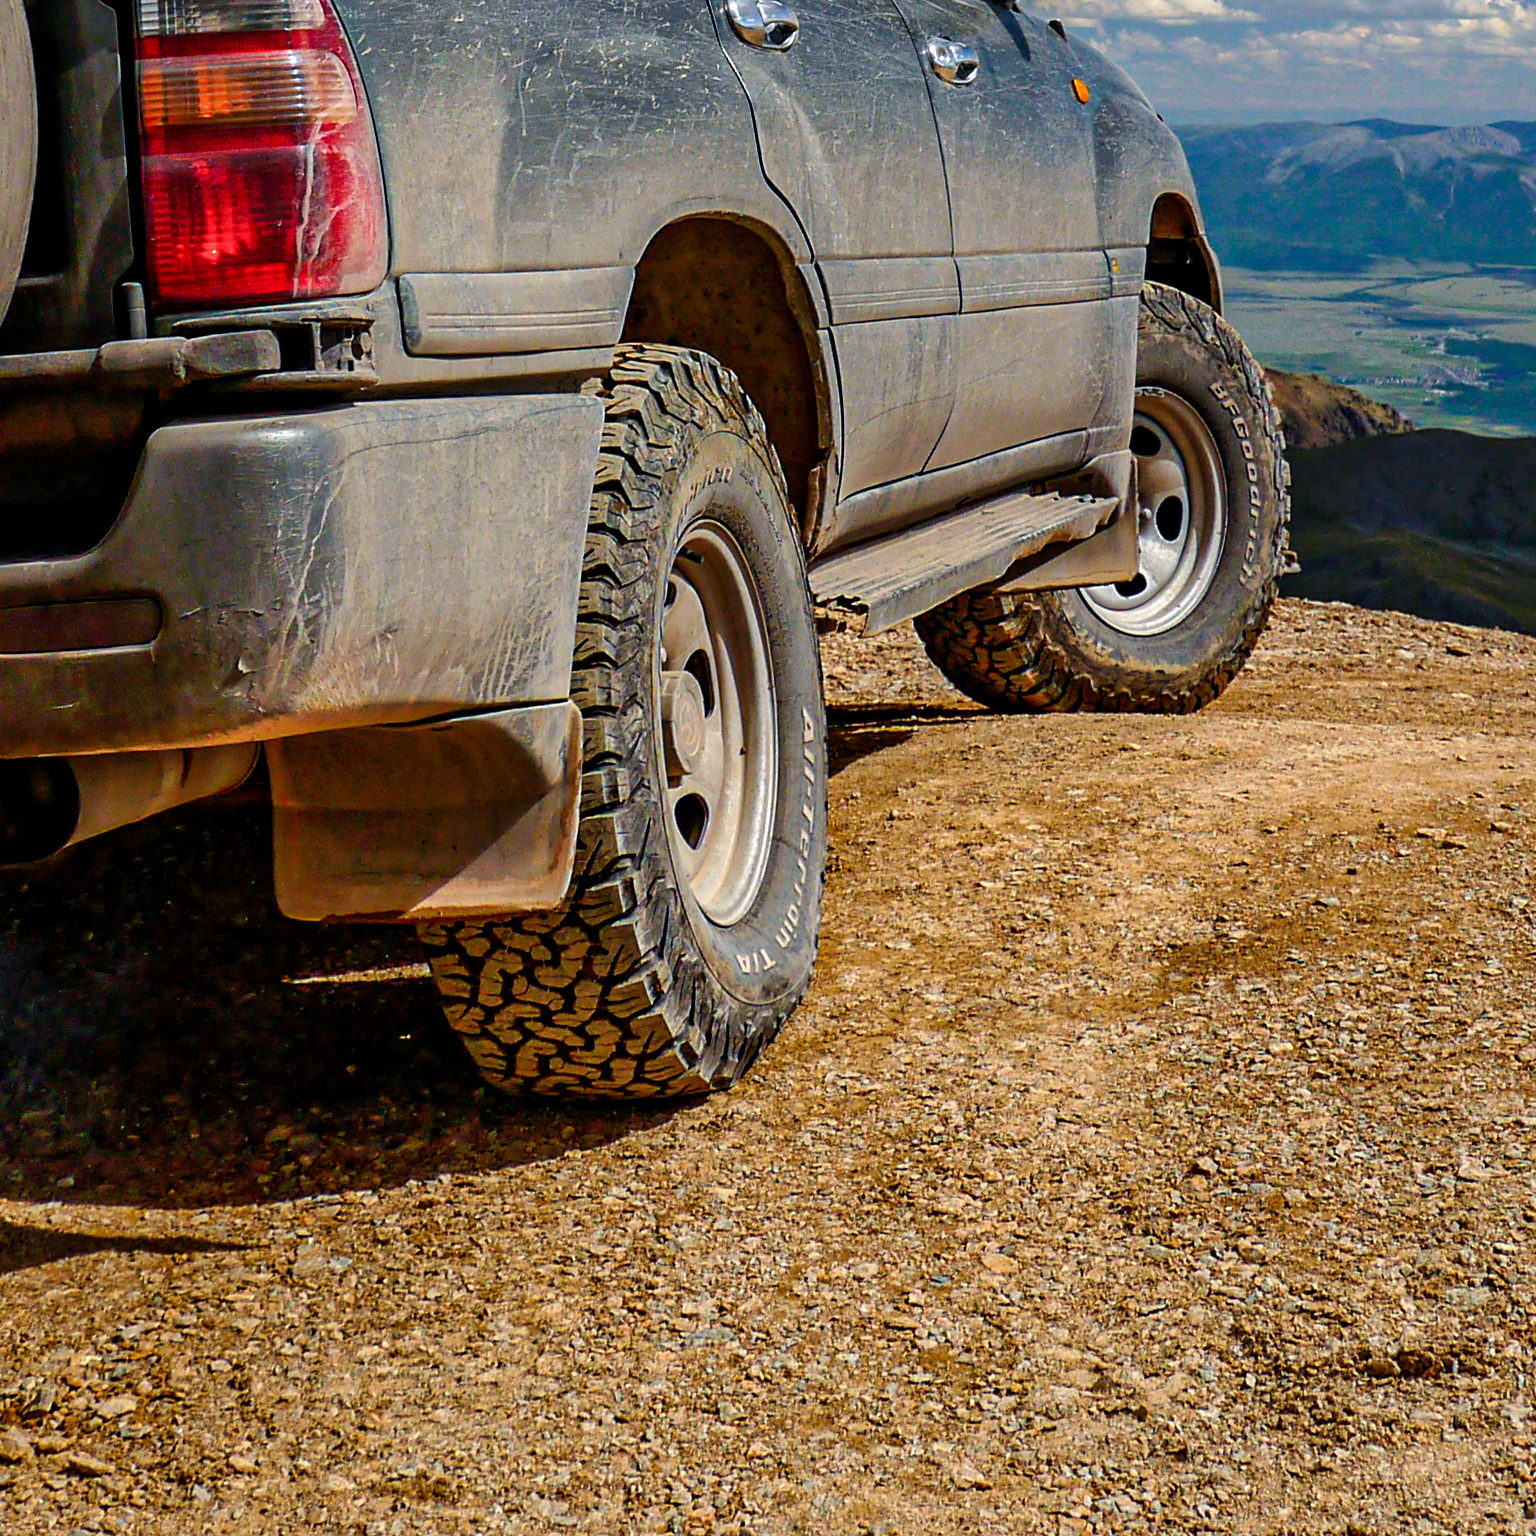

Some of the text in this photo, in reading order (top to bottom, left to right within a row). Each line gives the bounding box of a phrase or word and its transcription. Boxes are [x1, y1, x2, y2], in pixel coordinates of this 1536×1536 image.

[1209, 380, 1263, 586] BFGoodrich
[735, 706, 816, 975] All-Terrain T/A
